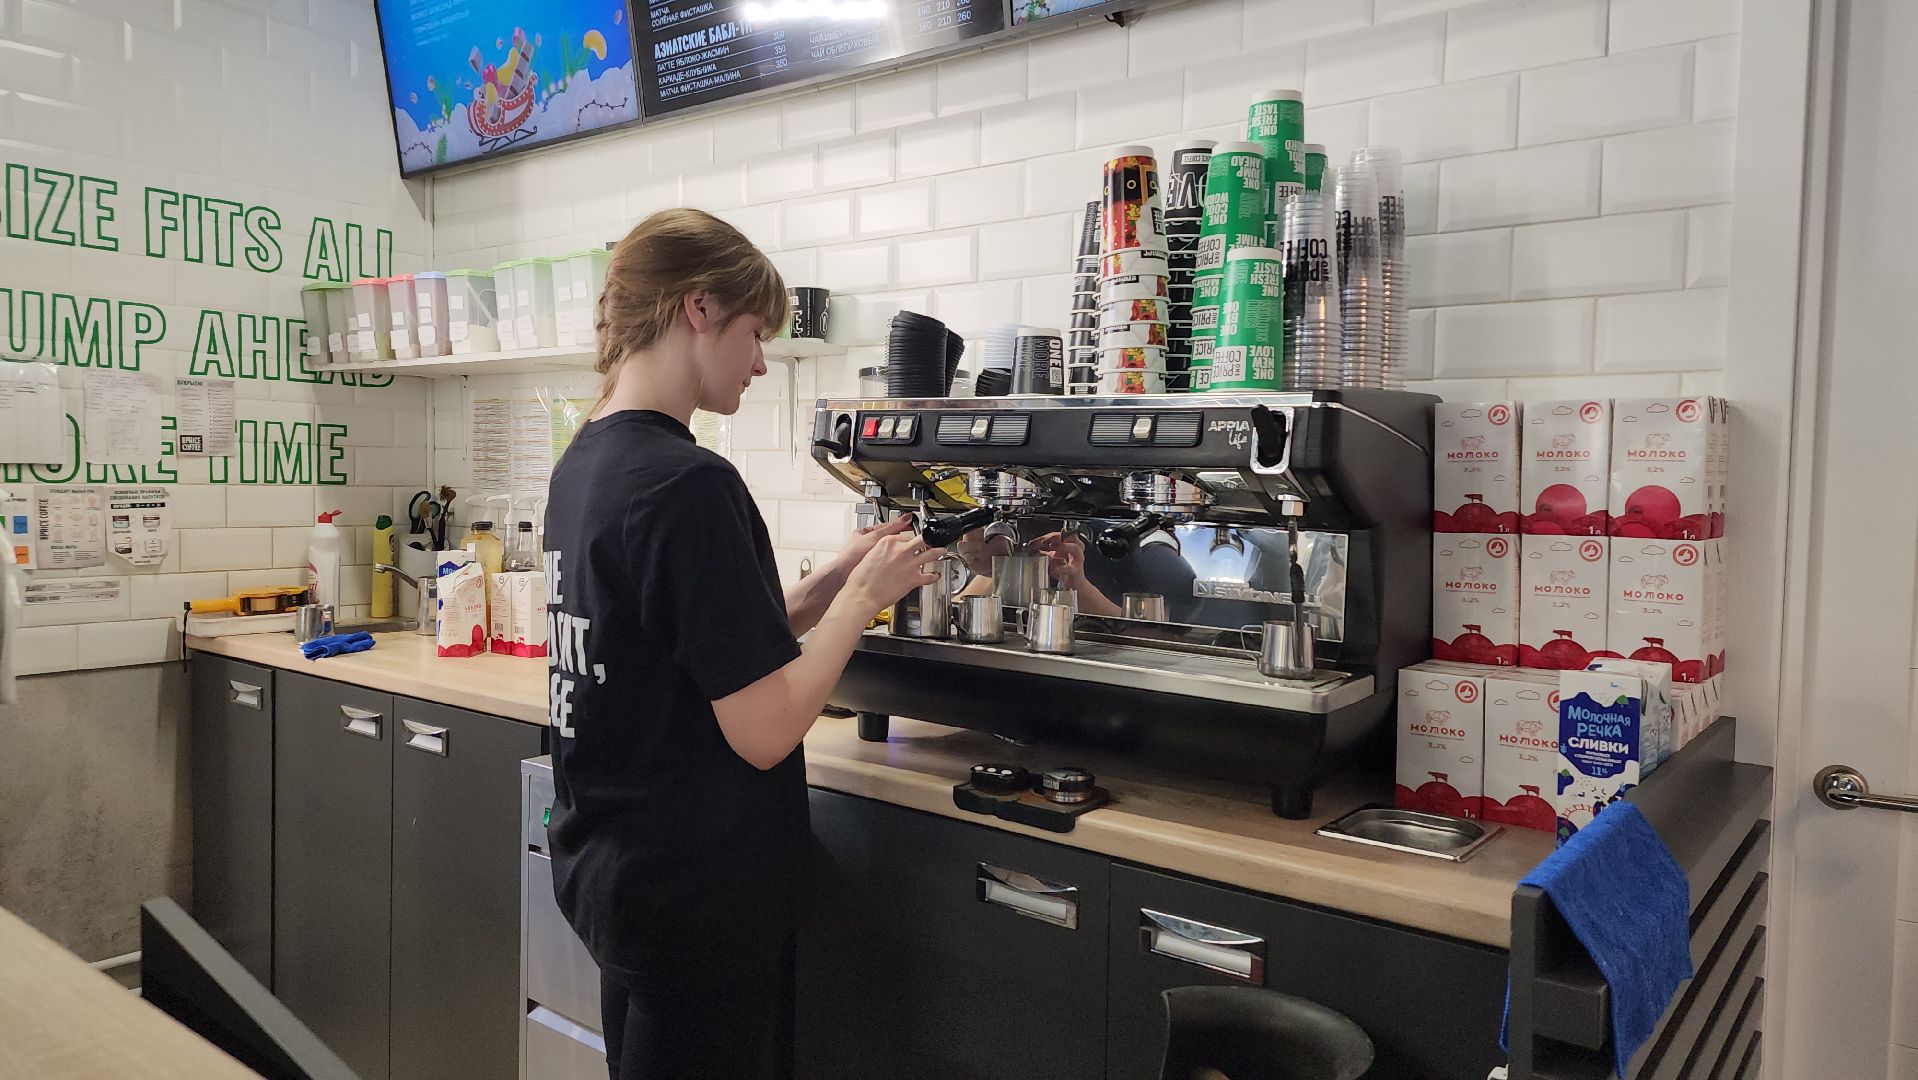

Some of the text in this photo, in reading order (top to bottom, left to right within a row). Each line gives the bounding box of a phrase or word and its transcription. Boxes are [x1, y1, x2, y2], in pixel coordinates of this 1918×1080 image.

[650, 6, 670, 19] МАТЧА
[680, 2, 714, 19] ФИСТАШКА
[811, 49, 825, 59] ЧАЙ
[937, 16, 952, 27] 210
[956, 10, 972, 23] 260
[654, 30, 708, 59] АЗИАТСКИЕ
[657, 30, 785, 73] ЛАТТЕ ЯБЛОКО-ЖАСМИН 350
[658, 45, 786, 85] КАРКАДЕ-КЛУБНИКА 350
[659, 57, 788, 98] МАТЧА ФИСТАШКА-МАЛИНА 350
[1259, 125, 1277, 136] ONE
[1231, 155, 1261, 167] AHEAD
[1236, 167, 1261, 178] JUMP
[1242, 178, 1260, 190] ONE
[0, 163, 118, 252] IZE
[145, 187, 283, 272] FITS
[1208, 213, 1228, 226] ONE
[1253, 262, 1279, 274] TASTE
[1250, 274, 1279, 285] FRESH
[1200, 285, 1219, 298] ONE
[1262, 285, 1279, 297] ONE
[1223, 301, 1240, 314] ONE
[1220, 323, 1238, 336] ONE
[1049, 339, 1062, 367] ONE
[1249, 345, 1275, 357] LOVE
[1031, 338, 1050, 379] MORE
[1252, 357, 1275, 368] NEW
[1252, 368, 1275, 380] ONE
[1208, 421, 1251, 432] APPIA
[209, 420, 348, 485] IME
[1447, 451, 1499, 459] МОЛОКО
[1536, 450, 1591, 458] МОЛОКО
[1627, 450, 1686, 459] МОЛОКО
[1445, 581, 1497, 590] МОЛОКО
[1534, 585, 1591, 595] МОЛОКО
[1623, 590, 1684, 601] МОЛОКО
[1410, 723, 1466, 737] МОЛОКО
[1499, 733, 1559, 749] МОЛОКО
[1568, 736, 1629, 755] СЛИВКИ
